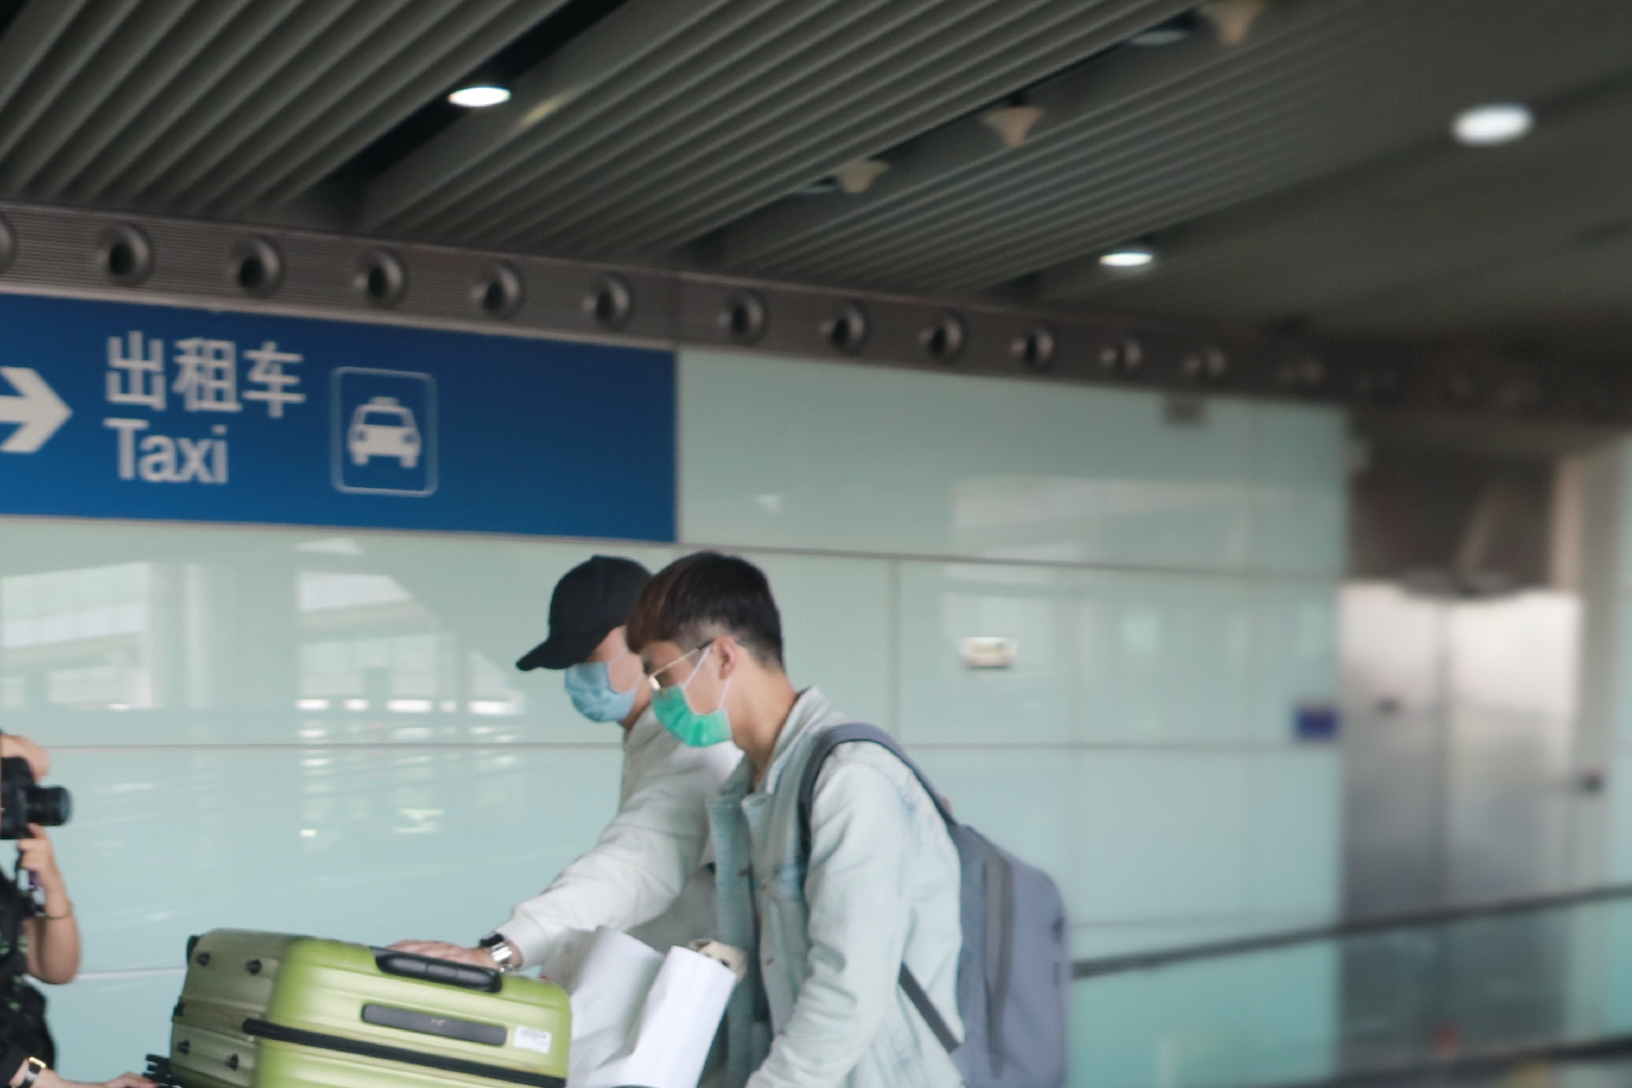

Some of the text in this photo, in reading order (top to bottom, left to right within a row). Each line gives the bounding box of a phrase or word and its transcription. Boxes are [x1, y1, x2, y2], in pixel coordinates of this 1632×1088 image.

[105, 330, 307, 419] 出租车
[102, 417, 229, 484] Taxi
